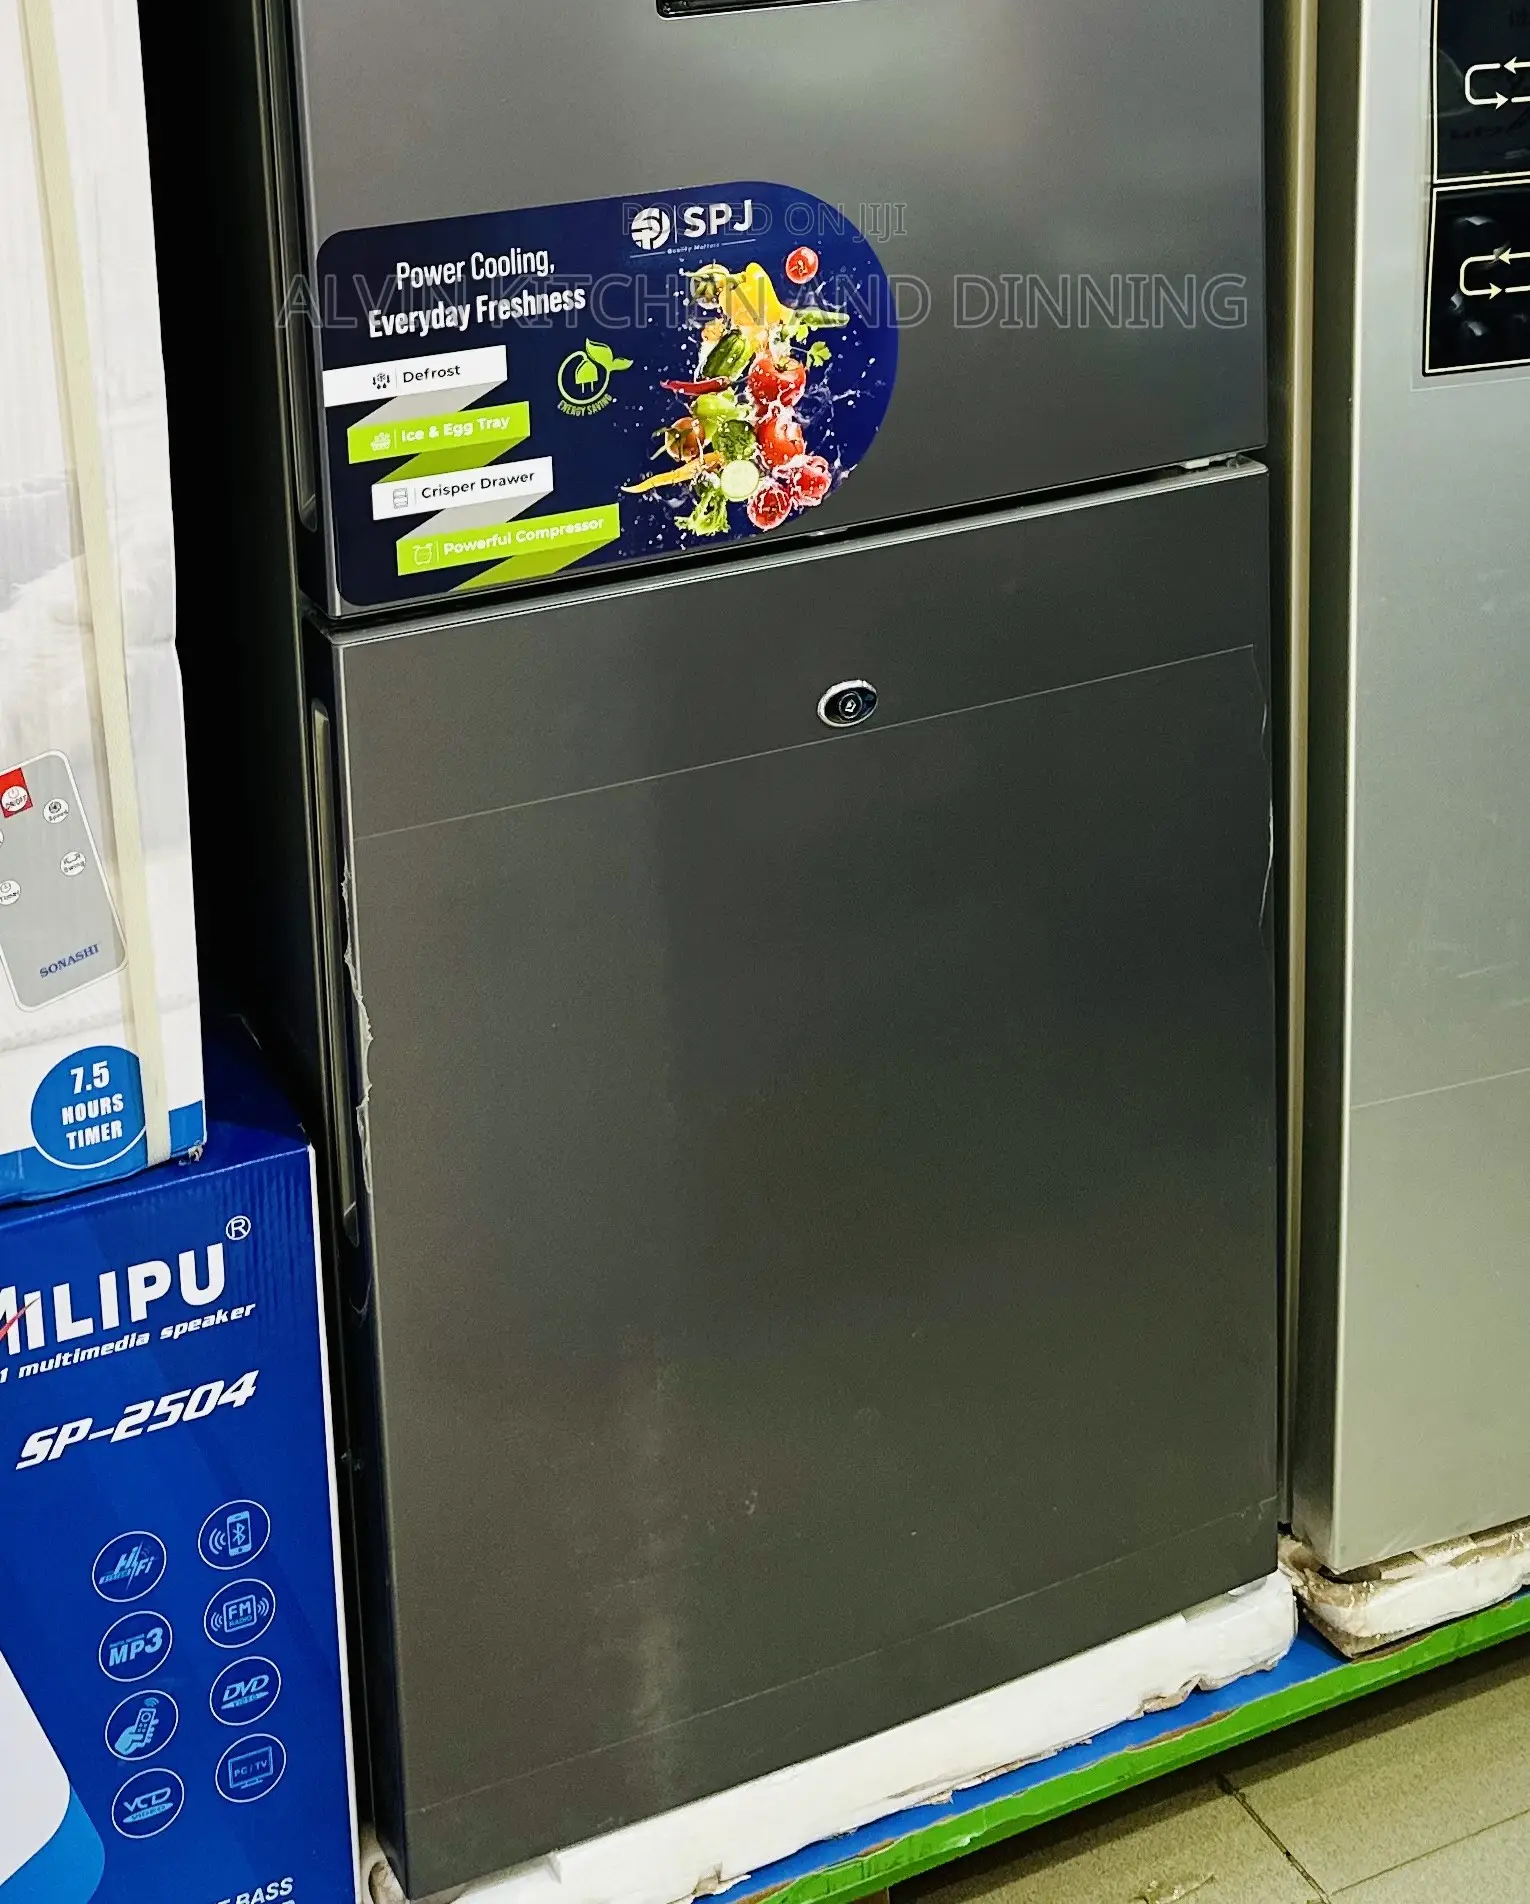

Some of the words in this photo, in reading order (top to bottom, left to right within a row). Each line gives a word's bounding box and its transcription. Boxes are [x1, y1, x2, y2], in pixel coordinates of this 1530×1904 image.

[683, 200, 753, 238] SPJ
[396, 259, 465, 291] Power
[471, 246, 555, 283] Cooling,
[369, 300, 471, 339] Everyday
[476, 285, 587, 325] Freshness
[402, 364, 462, 384] Defrost
[401, 427, 425, 443] Ice
[428, 425, 440, 438] &
[443, 421, 474, 439] Egg
[476, 414, 511, 433] Tray
[421, 480, 477, 501] Crisper
[480, 470, 535, 490] Drawer
[443, 532, 512, 556] Powerful
[515, 517, 604, 546] Compressor
[39, 943, 100, 978] SONASHI
[70, 1060, 110, 1095] 7.5
[61, 1093, 125, 1126] HOURS
[65, 1120, 123, 1150] TIMER
[18, 1331, 150, 1379] multimedia
[159, 1303, 256, 1341] speaker
[15, 1369, 260, 1471] SP-2504
[228, 1601, 252, 1620] FM
[108, 1627, 163, 1667] MP3
[222, 1674, 270, 1702] DVD
[123, 1786, 172, 1813] VCD
[235, 1876, 294, 1904] BASS
